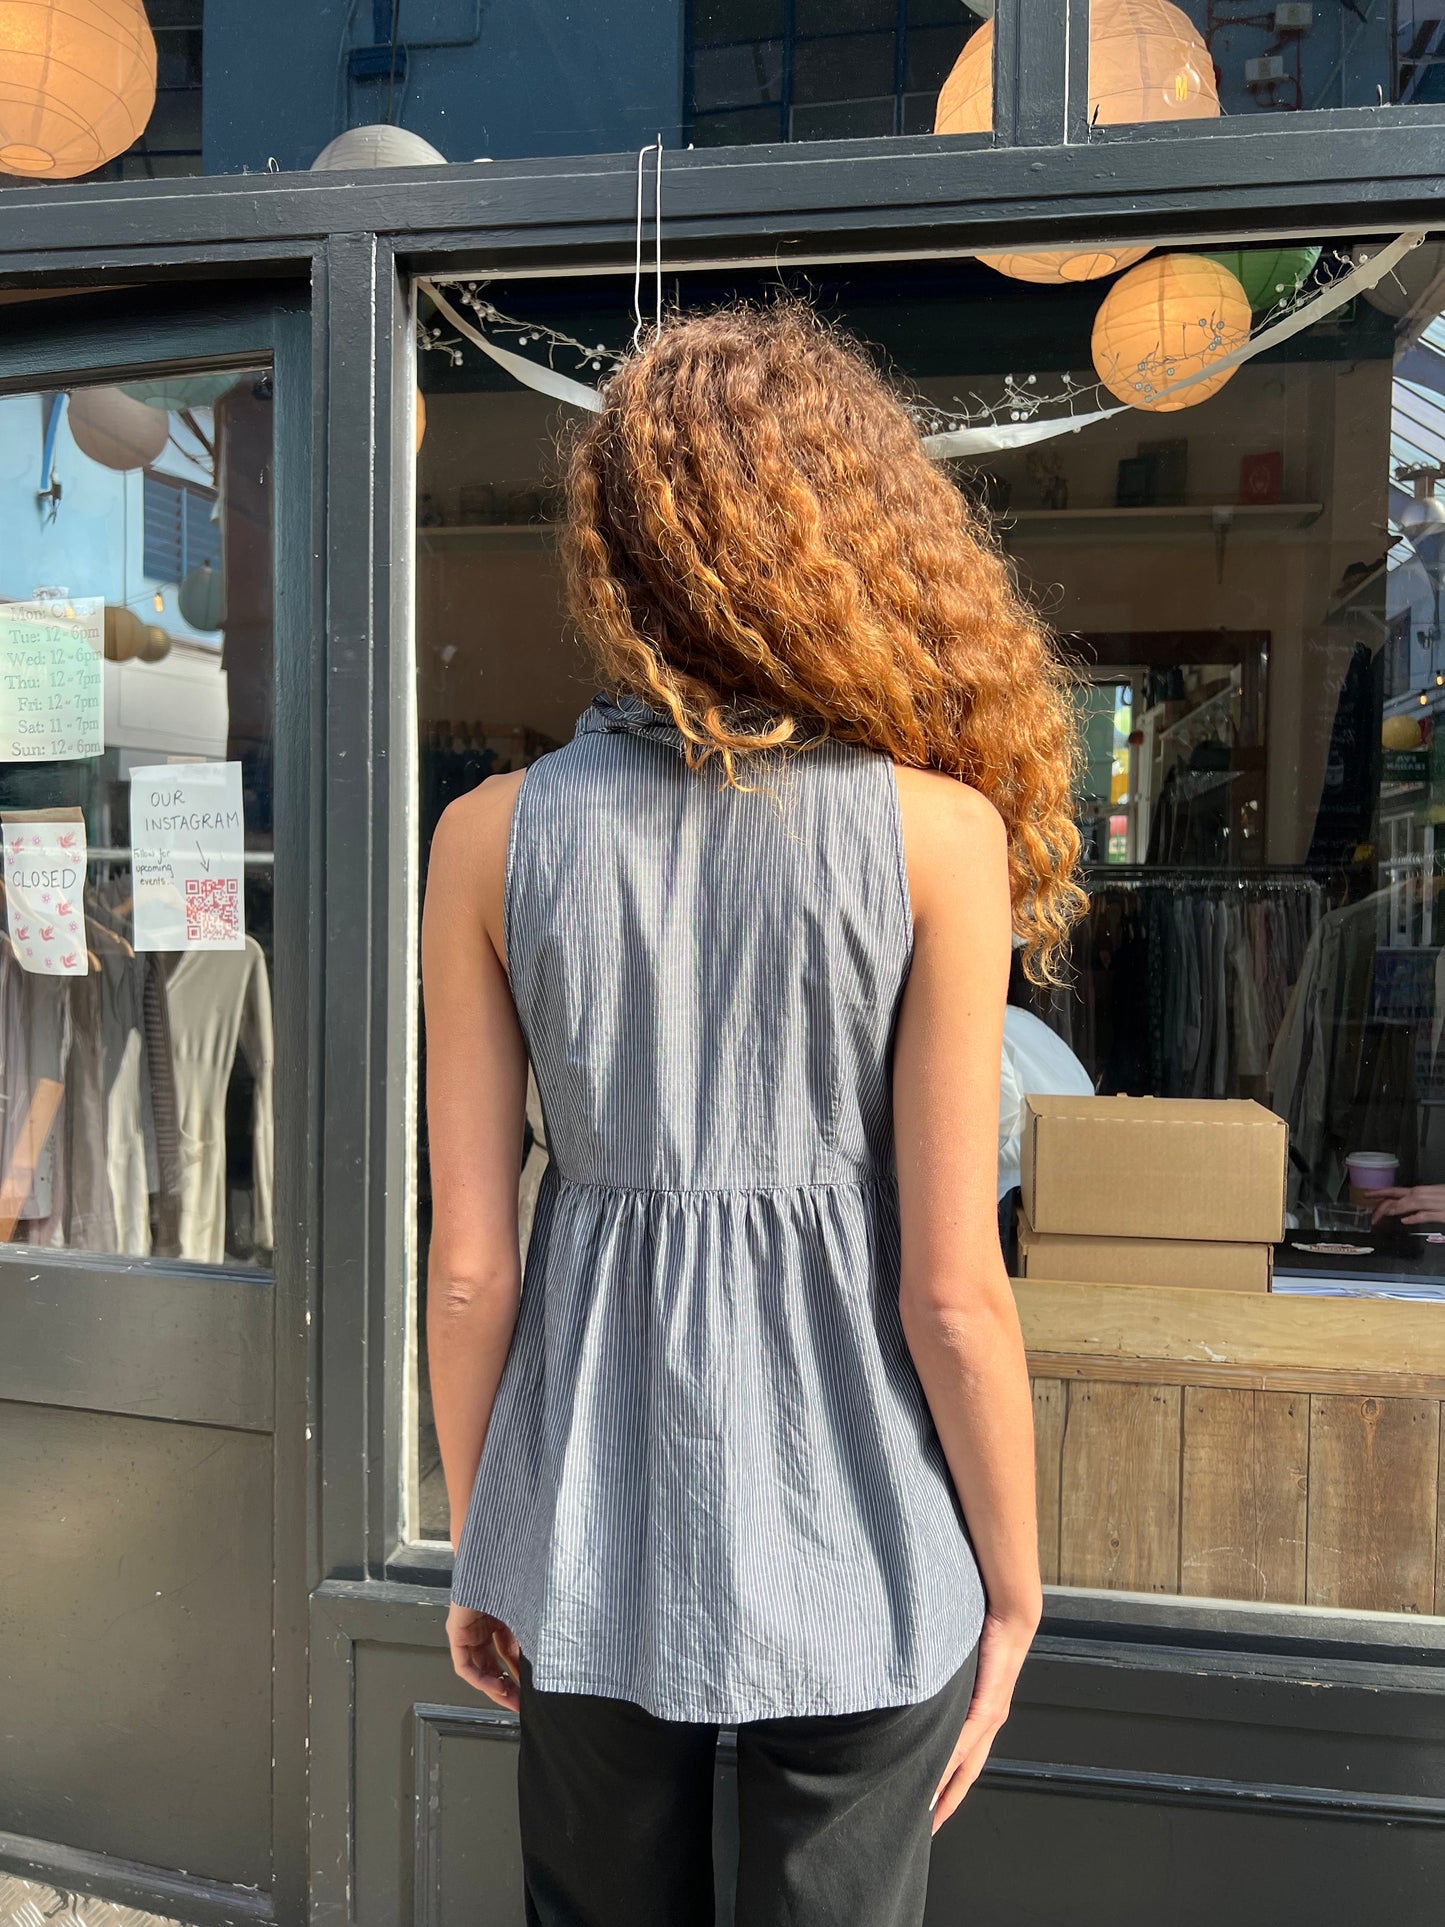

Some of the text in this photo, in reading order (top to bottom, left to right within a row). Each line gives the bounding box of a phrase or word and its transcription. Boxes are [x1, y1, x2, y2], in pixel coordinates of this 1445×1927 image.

[9, 601, 96, 621] Mon: Clsed
[9, 630, 40, 644] Tue:
[7, 651, 46, 666] Wed:
[4, 675, 40, 690] Thu:
[17, 697, 42, 711] Fri:
[18, 719, 44, 734] Sat:
[12, 741, 45, 757] Sun:
[150, 789, 185, 807] OUR
[145, 811, 239, 832] INSTAGRAM
[136, 863, 175, 878] upcoming
[12, 868, 77, 889] CLOSED
